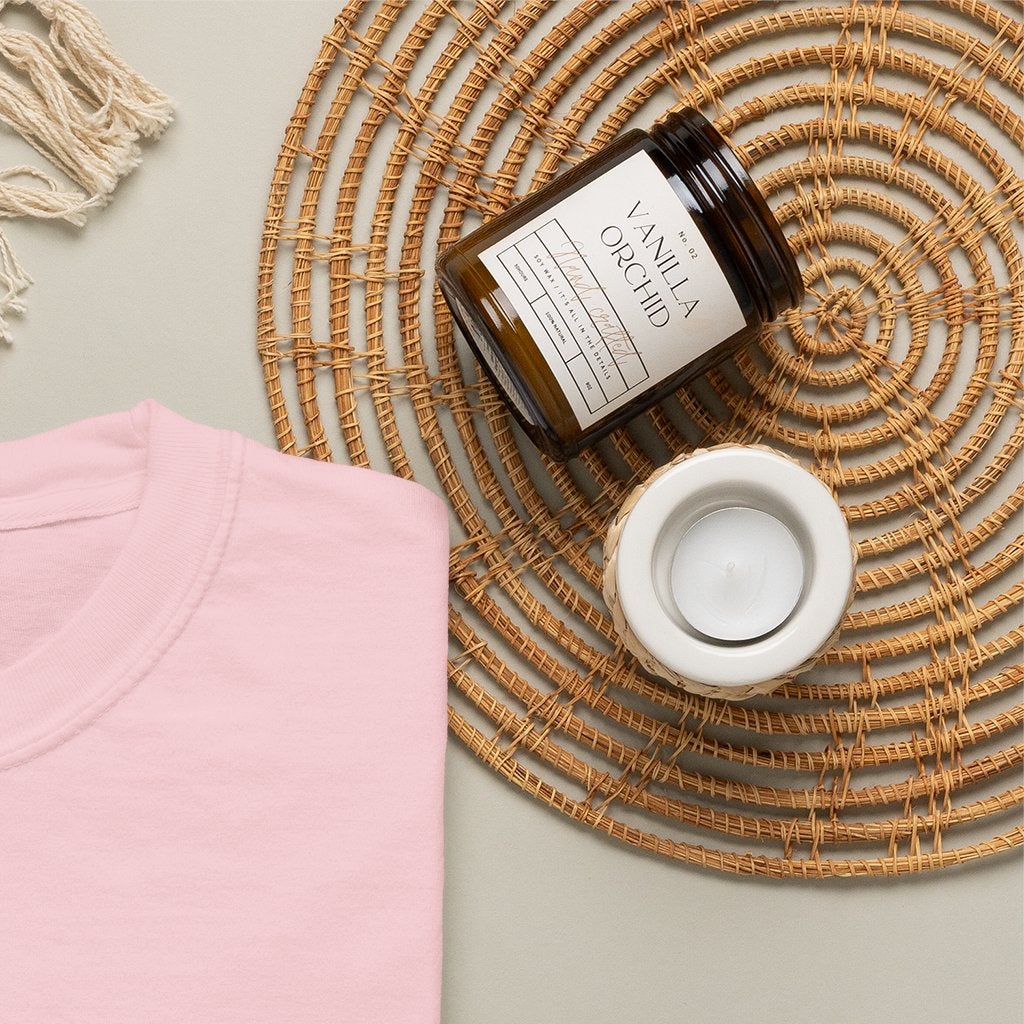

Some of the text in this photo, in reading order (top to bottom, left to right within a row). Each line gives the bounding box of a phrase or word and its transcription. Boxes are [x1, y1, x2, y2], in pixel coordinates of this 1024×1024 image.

[600, 225, 670, 328] ORCHID
[626, 200, 700, 319] VANILLA
[688, 247, 698, 260] 02
[533, 254, 545, 267] SOY
[543, 268, 555, 283] WAX
[568, 308, 578, 323] ALL
[578, 324, 586, 334] IN
[584, 335, 595, 349] THE
[593, 351, 611, 381] DETAILS
